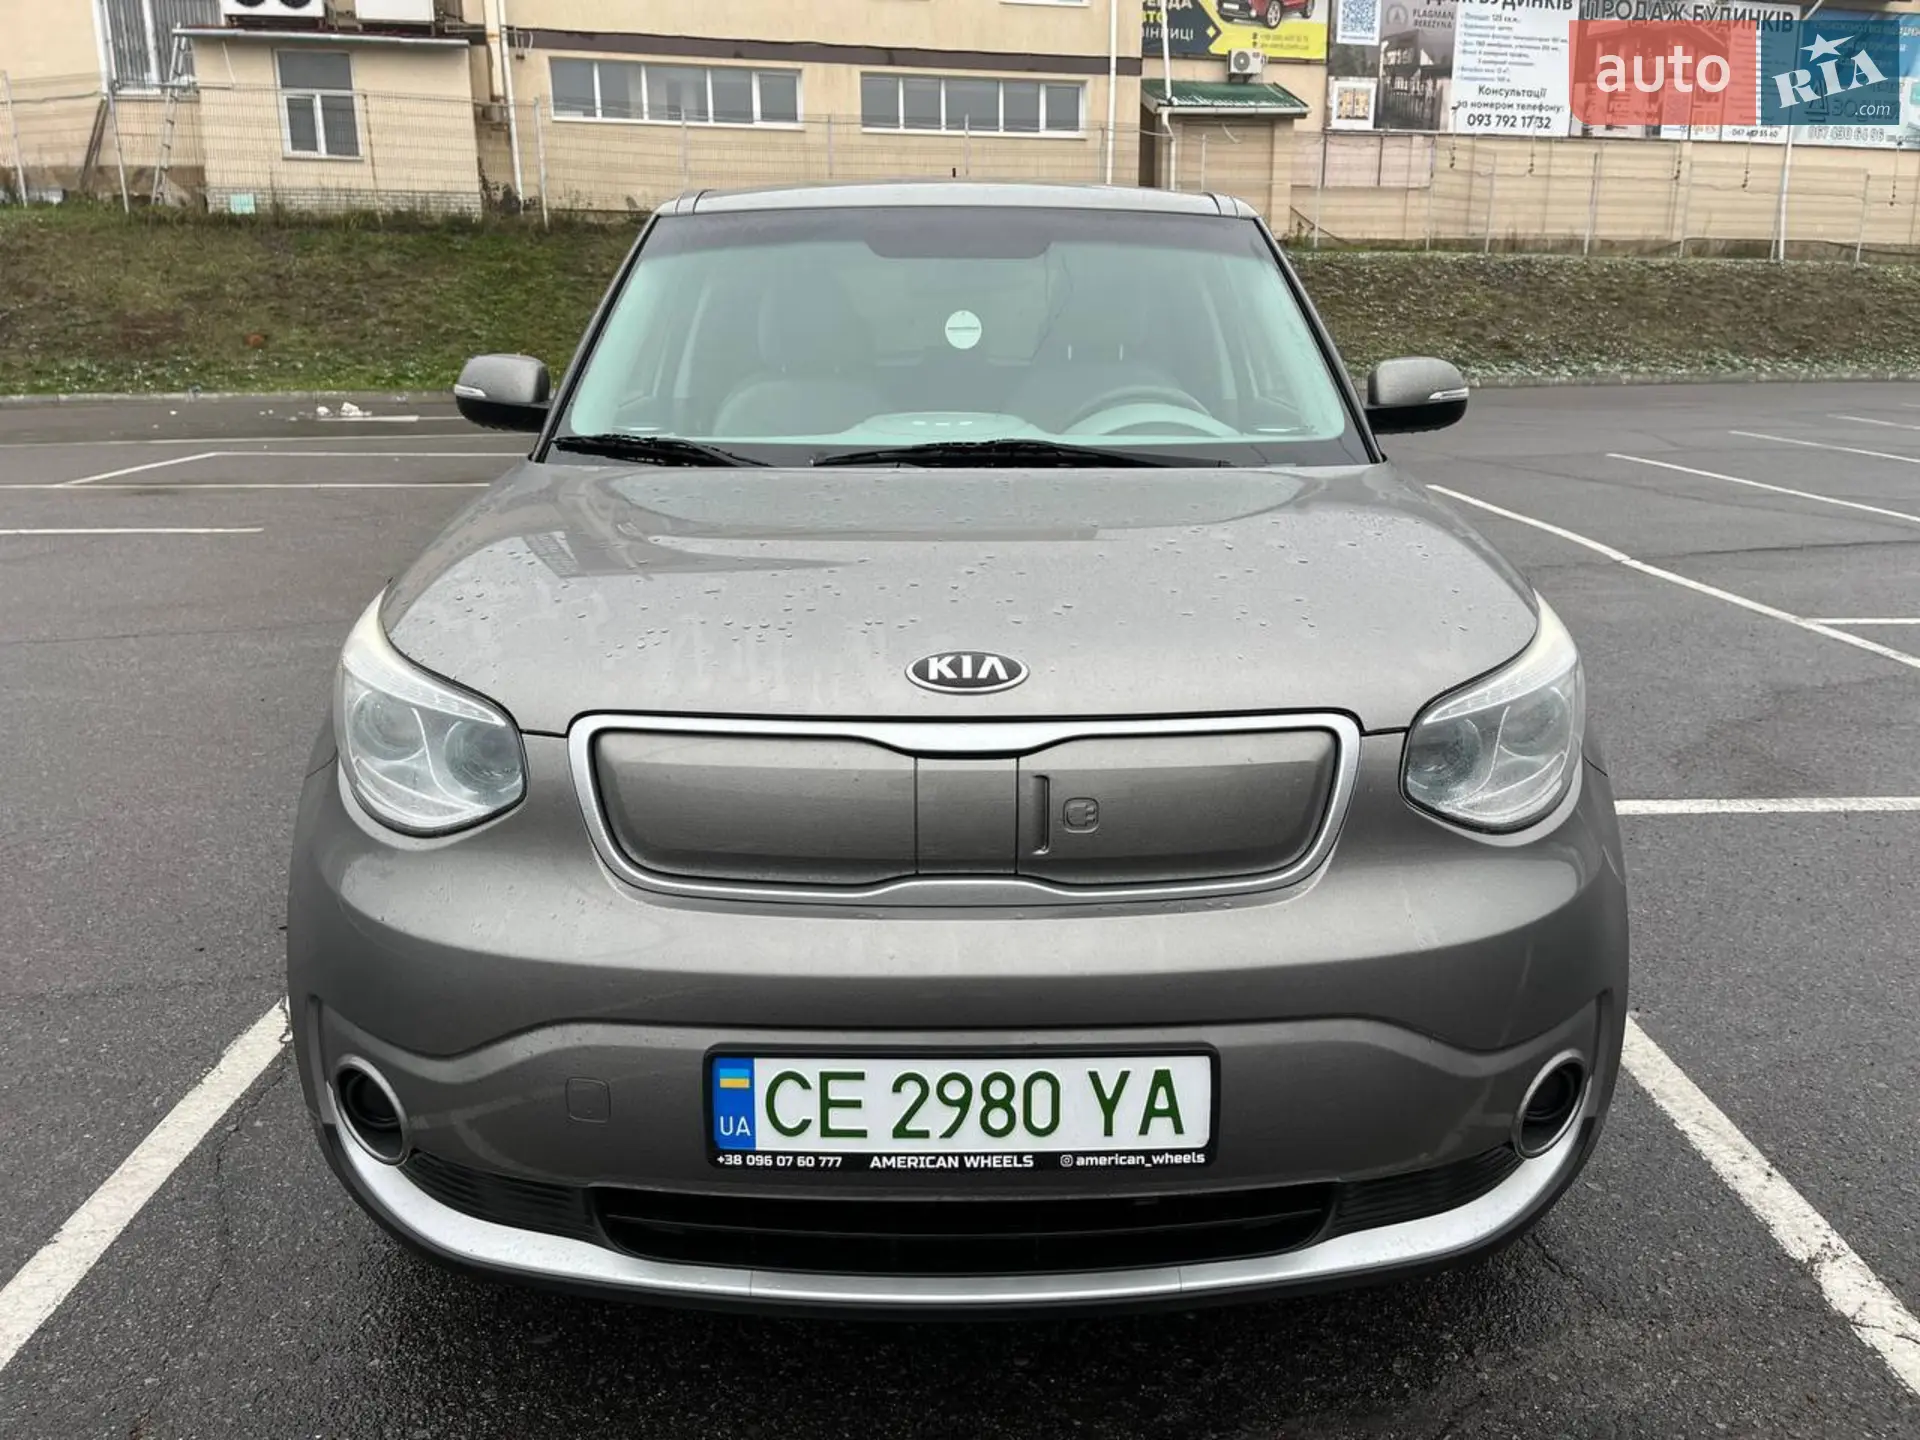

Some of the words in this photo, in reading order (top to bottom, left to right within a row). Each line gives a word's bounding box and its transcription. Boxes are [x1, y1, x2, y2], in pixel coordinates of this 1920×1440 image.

[1478, 85, 1547, 98] Консультації
[1470, 101, 1513, 111] номером
[1466, 113, 1491, 127] 093
[1496, 115, 1516, 128] 792
[928, 654, 1009, 680] KIA
[719, 1115, 751, 1137] UA
[765, 1070, 868, 1138] CE
[891, 1071, 1062, 1139] 2980
[1087, 1069, 1185, 1137] YA
[717, 1154, 742, 1166] +38
[746, 1155, 773, 1167] 096
[776, 1156, 793, 1168] 07
[818, 1156, 842, 1168] 777
[869, 1155, 960, 1169] AMERICAN
[964, 1155, 1034, 1169] WHEELS
[1076, 1152, 1206, 1168] american_wheels
